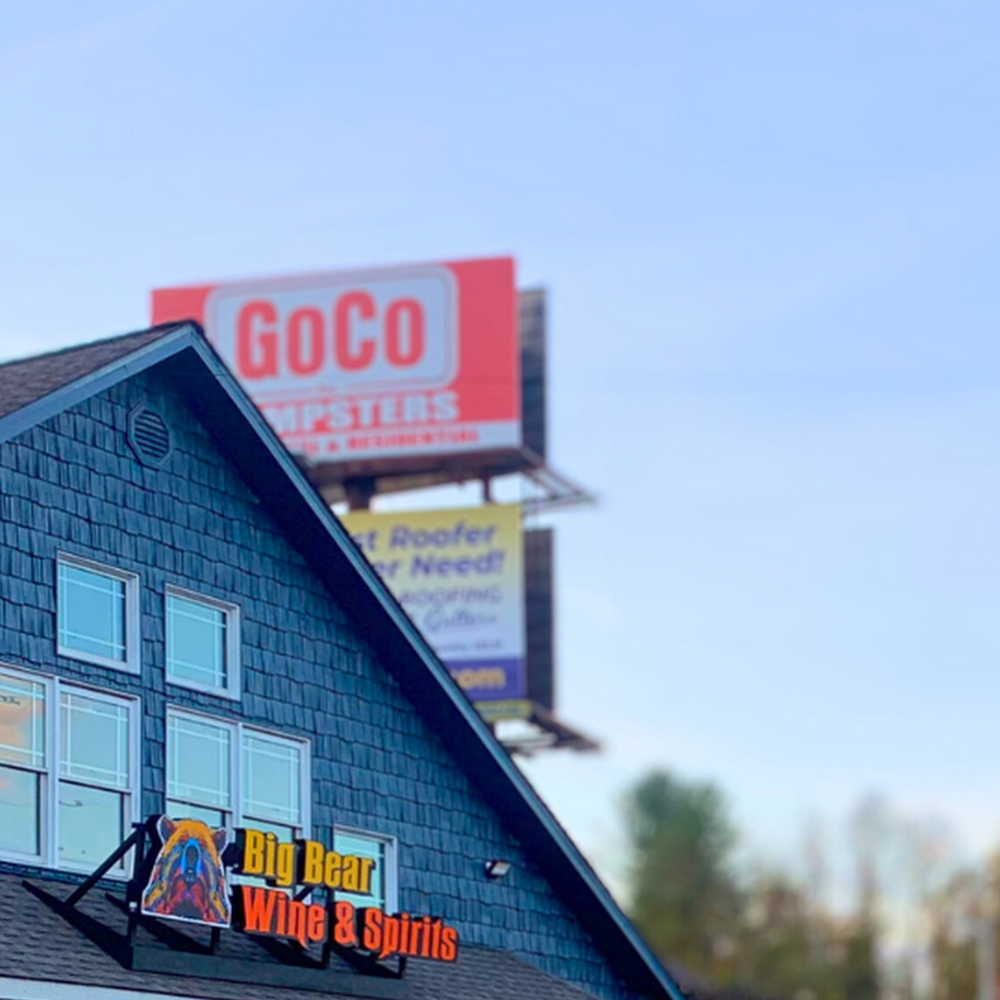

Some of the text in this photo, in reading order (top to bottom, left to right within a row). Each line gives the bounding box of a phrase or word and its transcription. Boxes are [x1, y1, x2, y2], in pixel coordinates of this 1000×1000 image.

[391, 521, 495, 549] Roofer
[242, 829, 374, 893] Big Bear
[241, 885, 458, 961] Wine & Spirits
